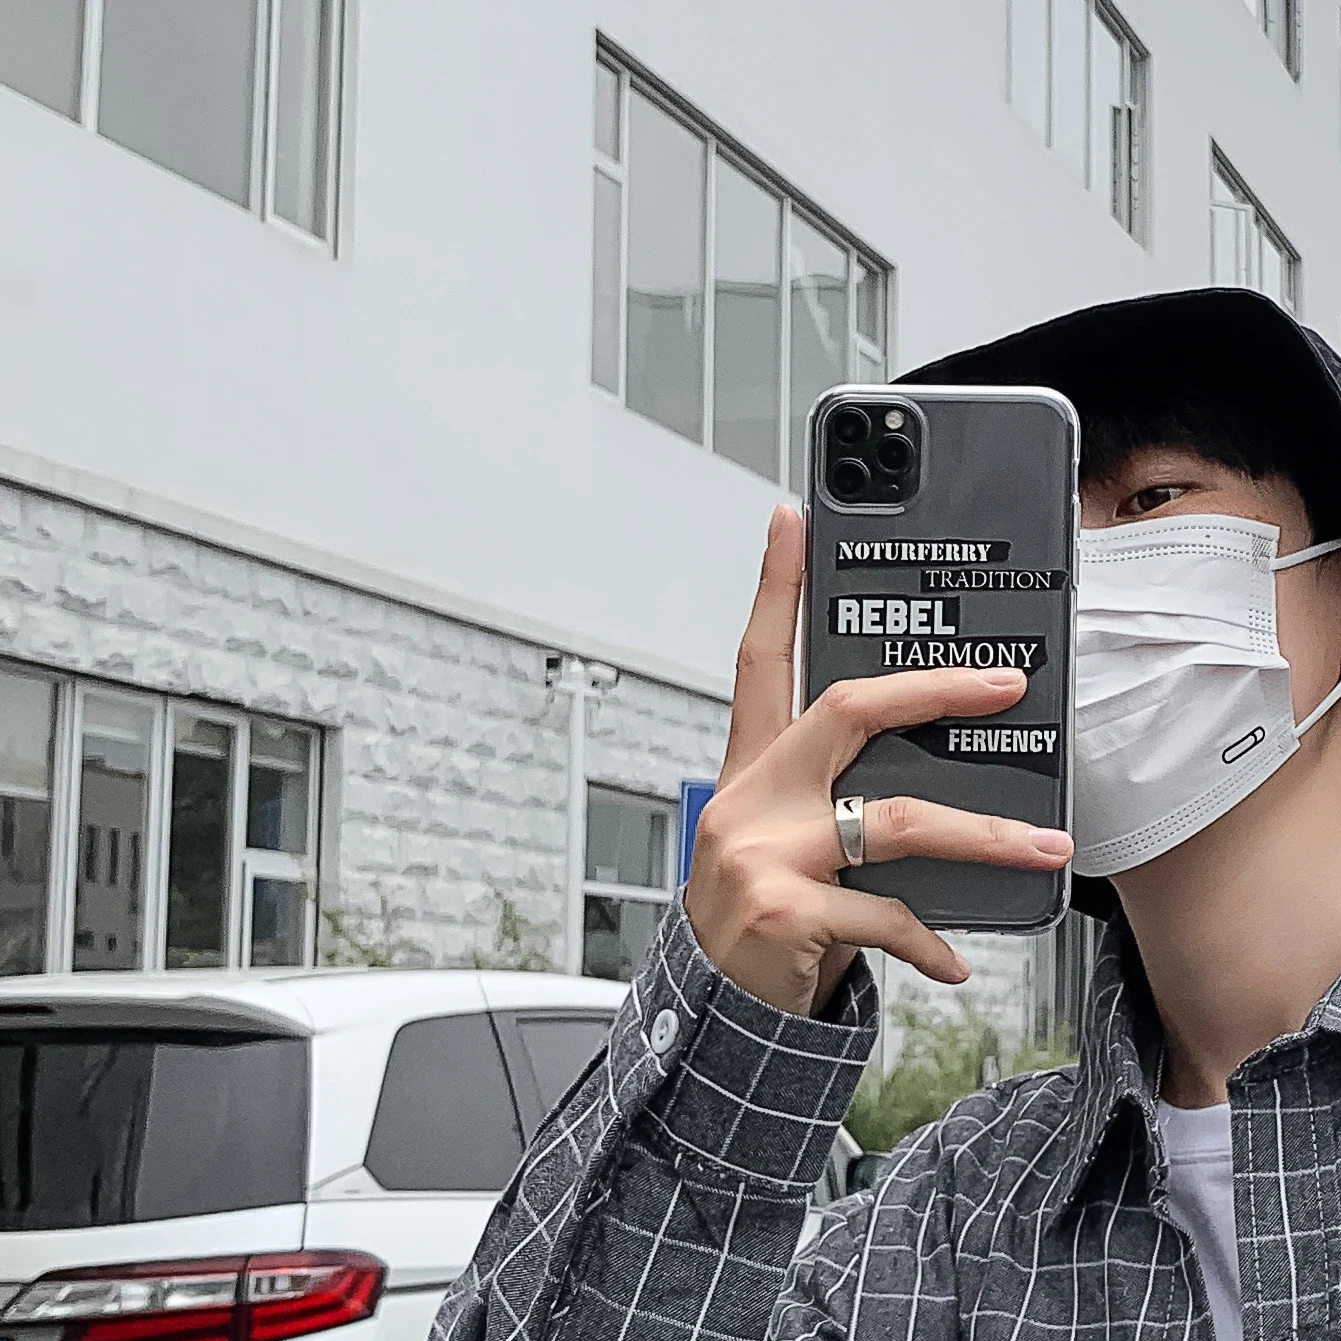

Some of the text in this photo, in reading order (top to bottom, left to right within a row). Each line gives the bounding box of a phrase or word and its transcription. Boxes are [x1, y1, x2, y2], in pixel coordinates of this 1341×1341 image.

[838, 541, 990, 562] NOTURFERRY
[925, 570, 1052, 588] TRADITION
[837, 599, 956, 634] REBEL
[883, 642, 1038, 668] HARMONY
[948, 729, 1057, 753] FERVENCY
